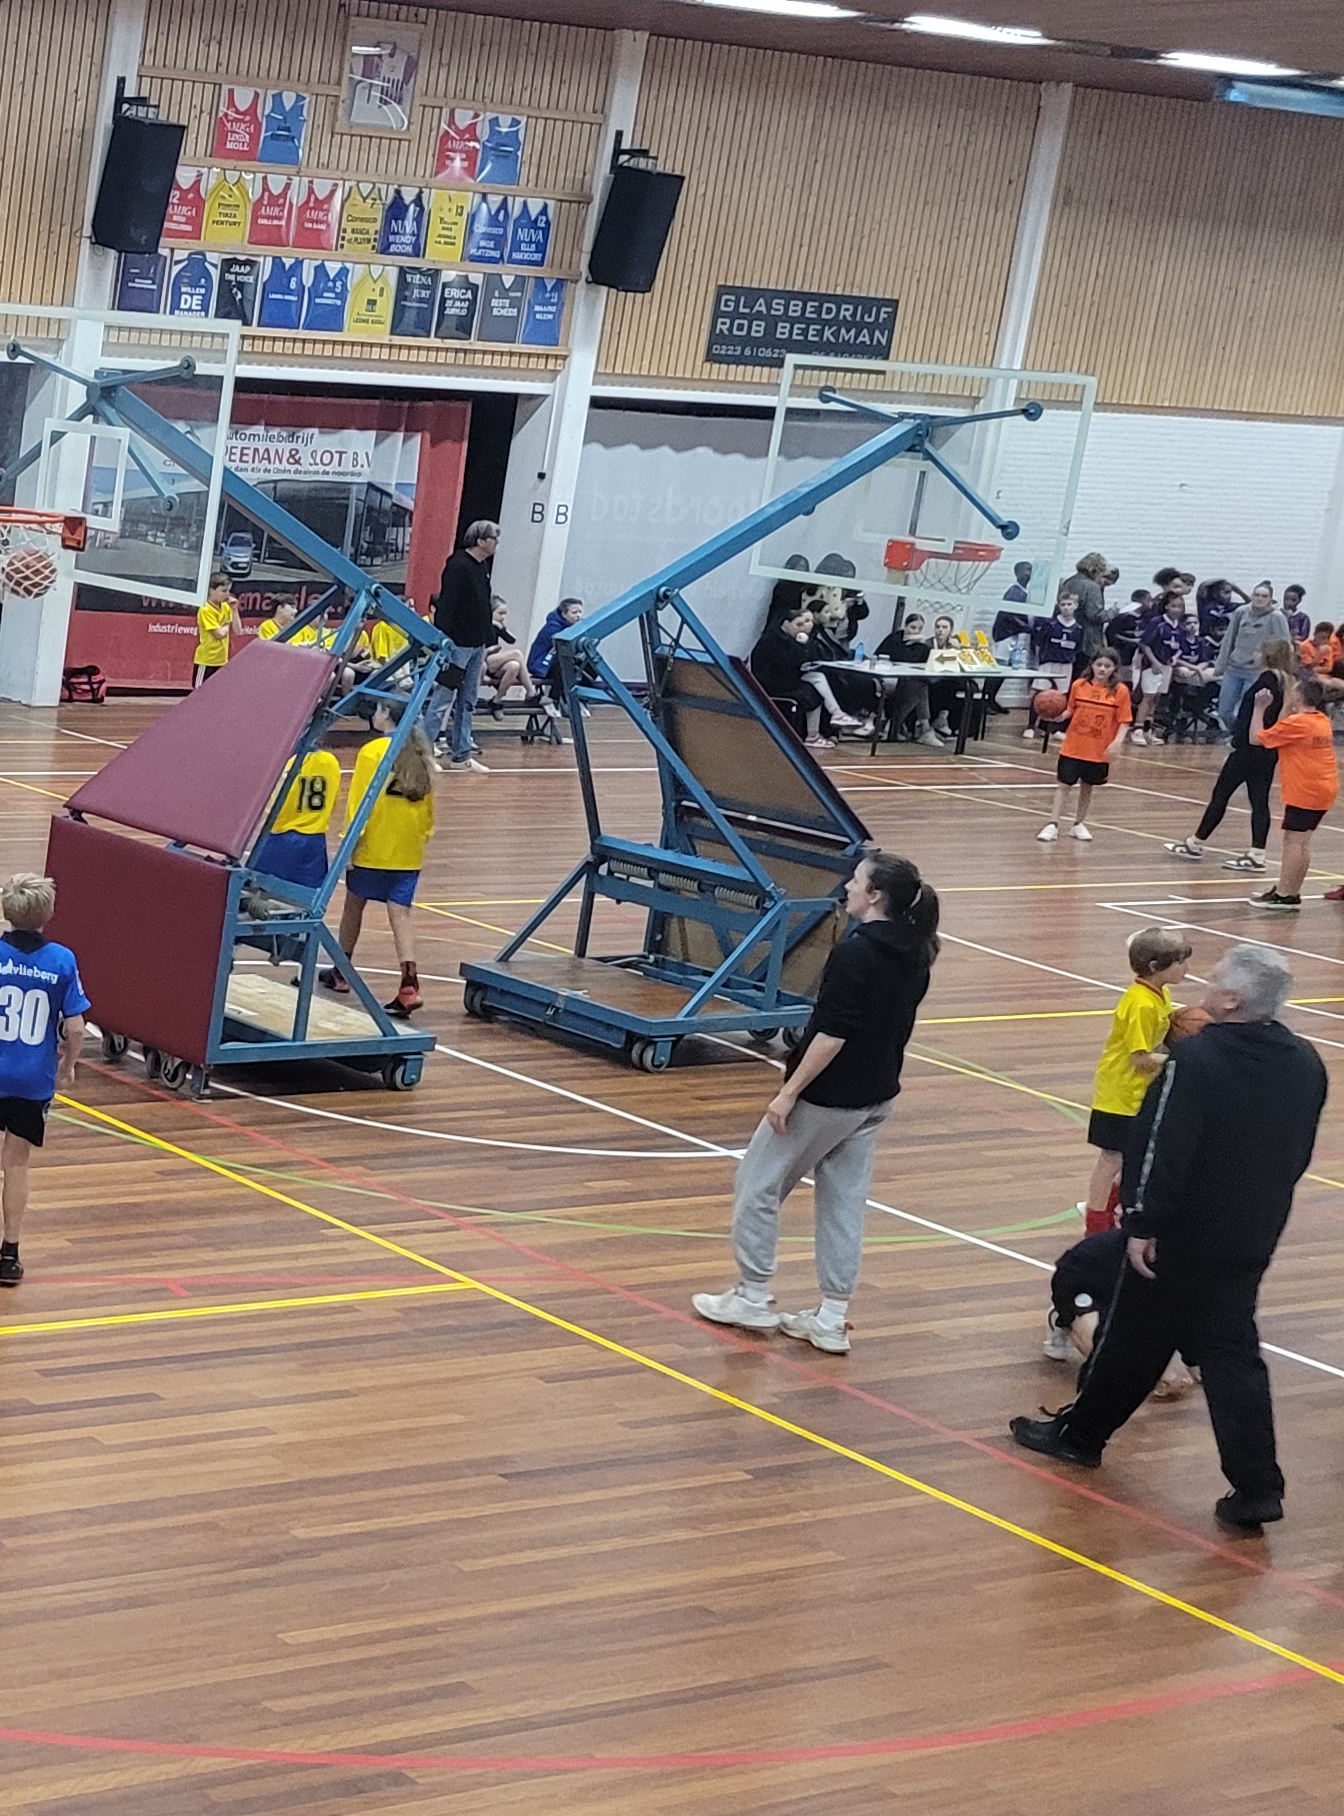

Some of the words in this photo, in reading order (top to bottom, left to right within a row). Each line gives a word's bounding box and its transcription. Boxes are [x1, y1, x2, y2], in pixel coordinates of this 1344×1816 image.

[226, 140, 250, 151] MOLL
[537, 215, 547, 227] 12
[517, 228, 543, 243] NUVA
[180, 294, 203, 310] DE
[444, 288, 472, 300] ERICA
[720, 294, 893, 323] GLASBEDRIJF
[715, 318, 766, 337] ROB
[775, 322, 889, 346] BEEKMAN
[712, 344, 741, 356] 0223
[744, 346, 786, 358] 610623
[286, 447, 303, 466] &
[530, 502, 545, 524] B
[554, 503, 570, 525] B
[297, 776, 326, 812] 18
